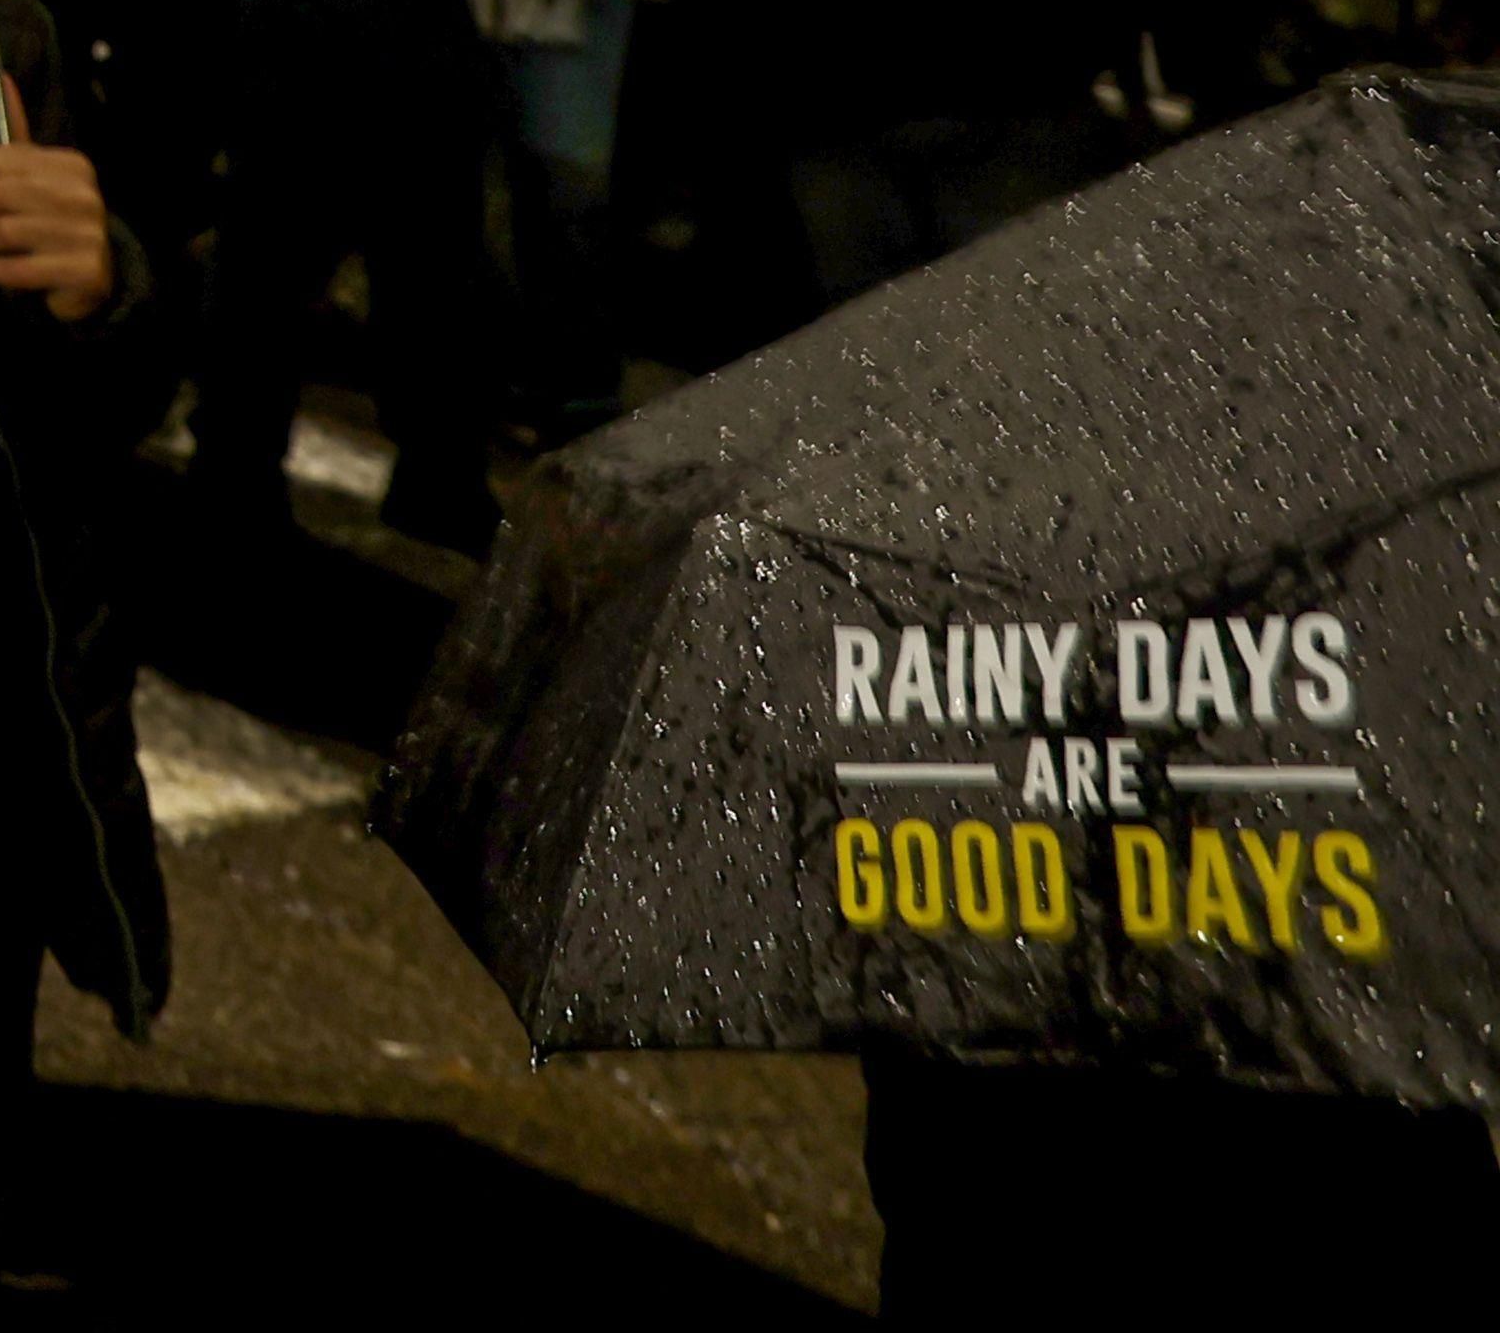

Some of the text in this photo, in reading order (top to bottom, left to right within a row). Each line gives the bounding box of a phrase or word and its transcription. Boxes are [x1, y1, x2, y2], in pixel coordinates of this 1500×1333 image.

[834, 611, 1356, 727] RAINY DAYS
[1021, 736, 1146, 814] ARE
[835, 817, 1392, 963] GOOD DAYS
